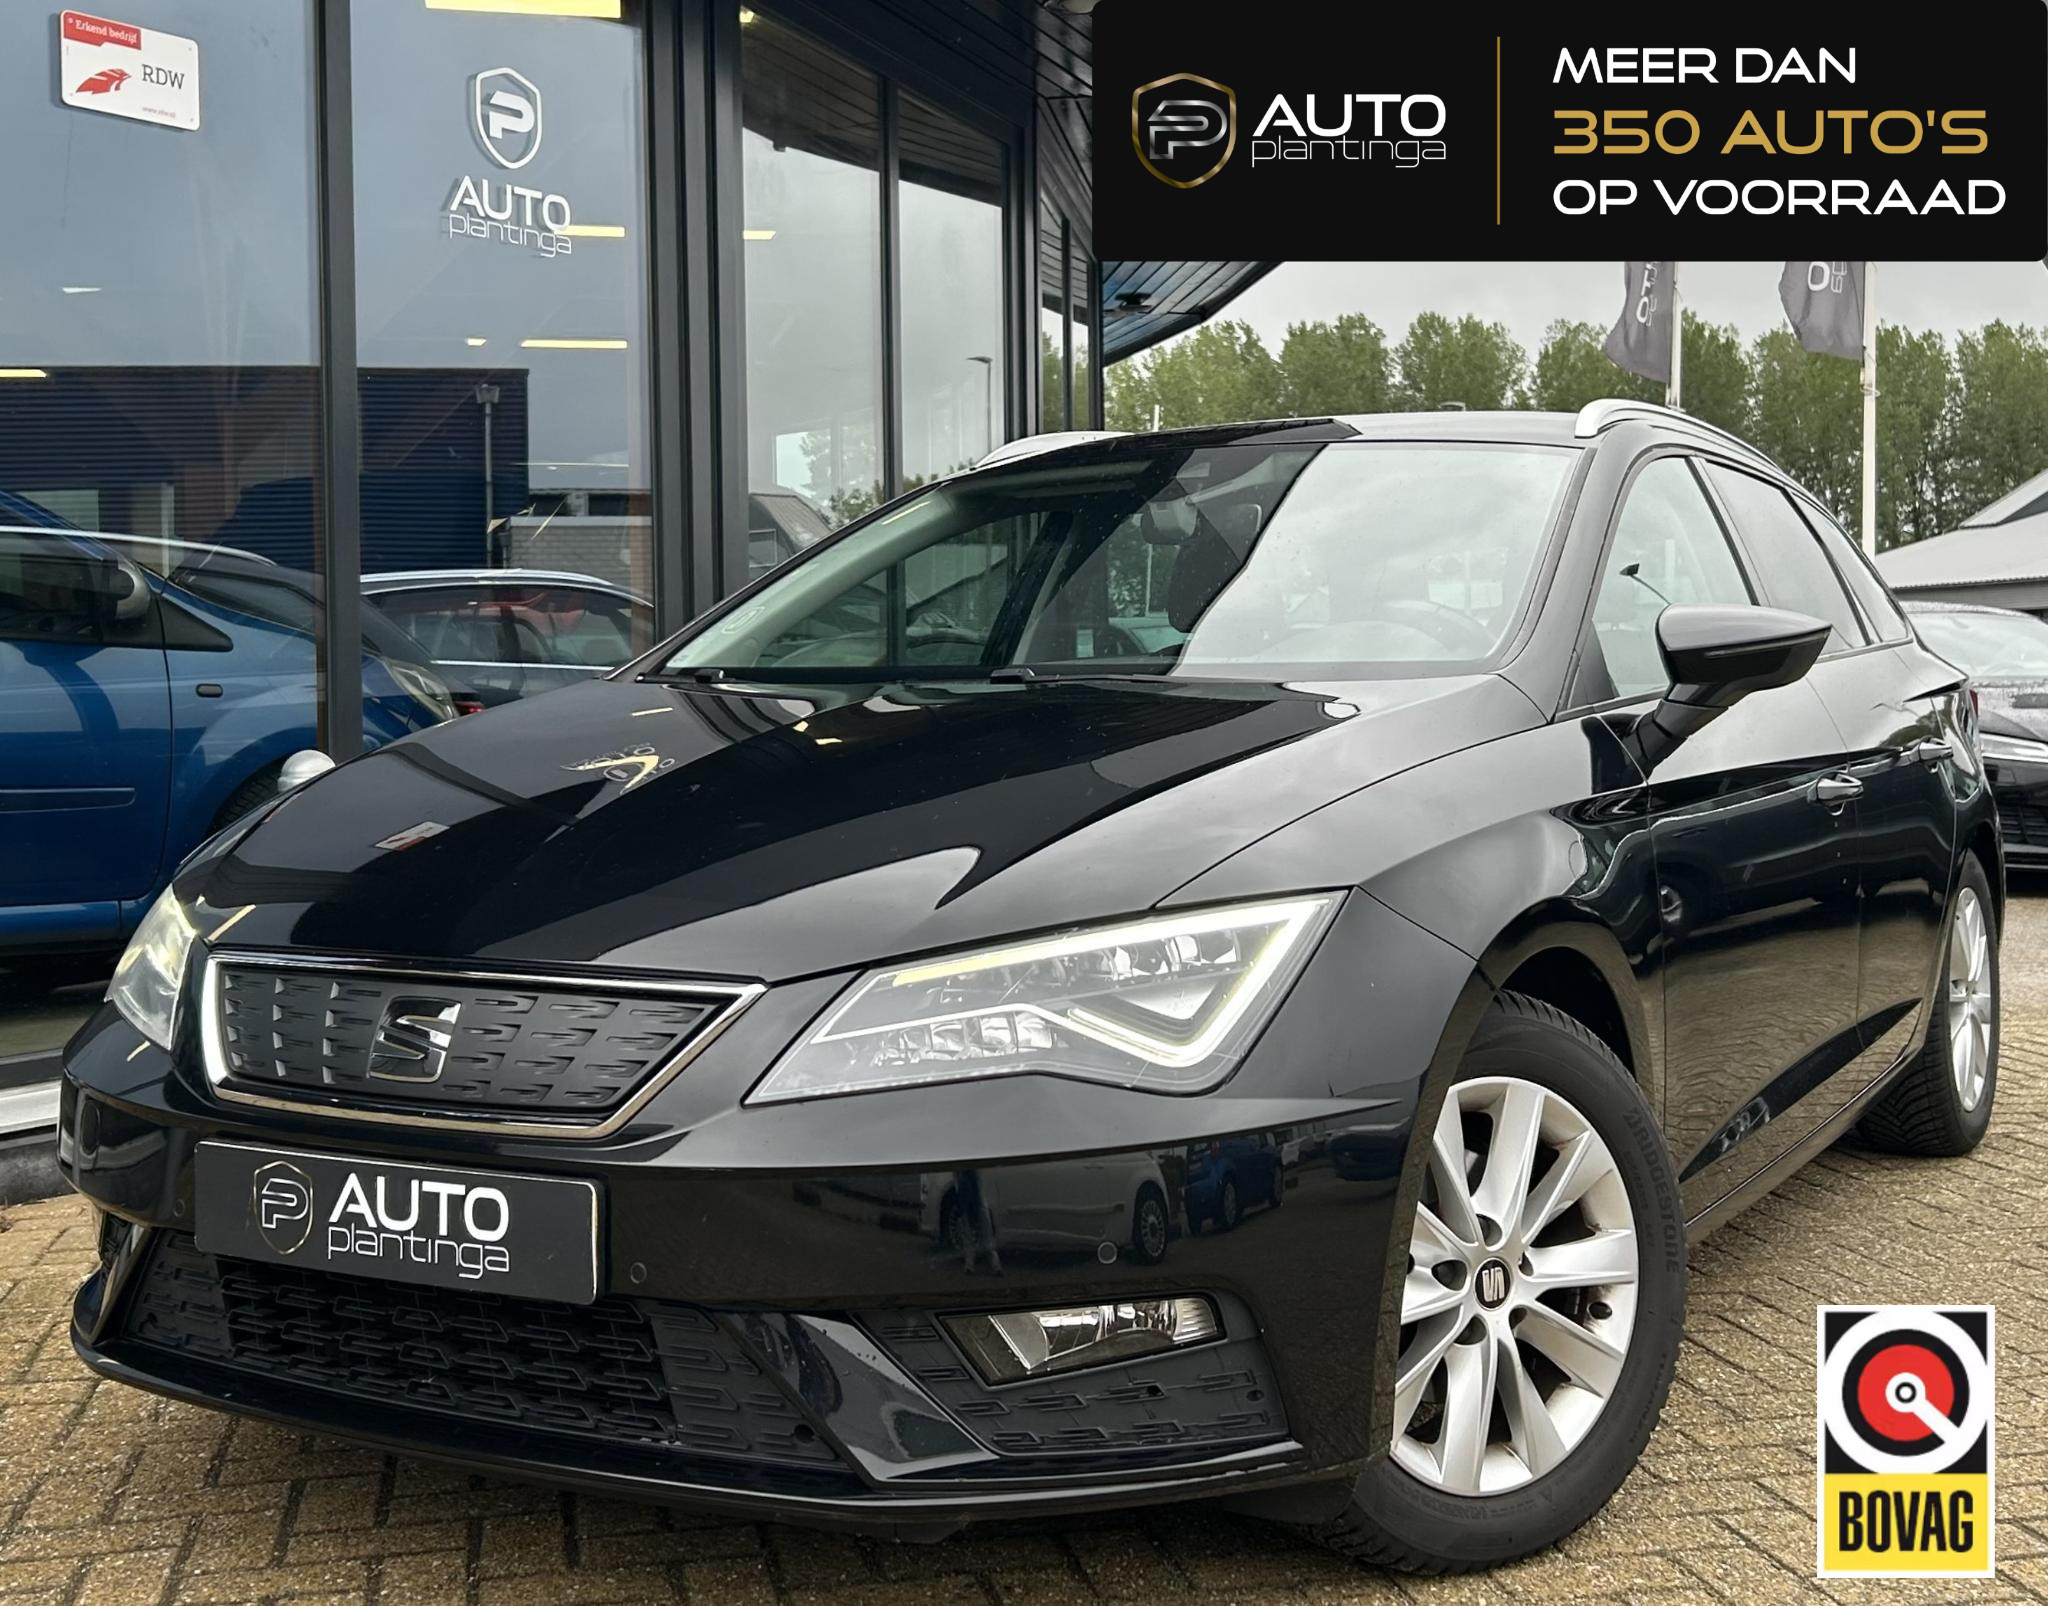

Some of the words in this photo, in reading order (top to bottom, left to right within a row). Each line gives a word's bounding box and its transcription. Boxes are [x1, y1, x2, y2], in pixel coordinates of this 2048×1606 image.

[75, 19, 108, 36] Erkend
[142, 63, 185, 90] RDW
[450, 175, 571, 231] AUTO
[450, 212, 572, 258] plantinga
[328, 1172, 509, 1242] AUTO
[328, 1223, 509, 1279] plantinga
